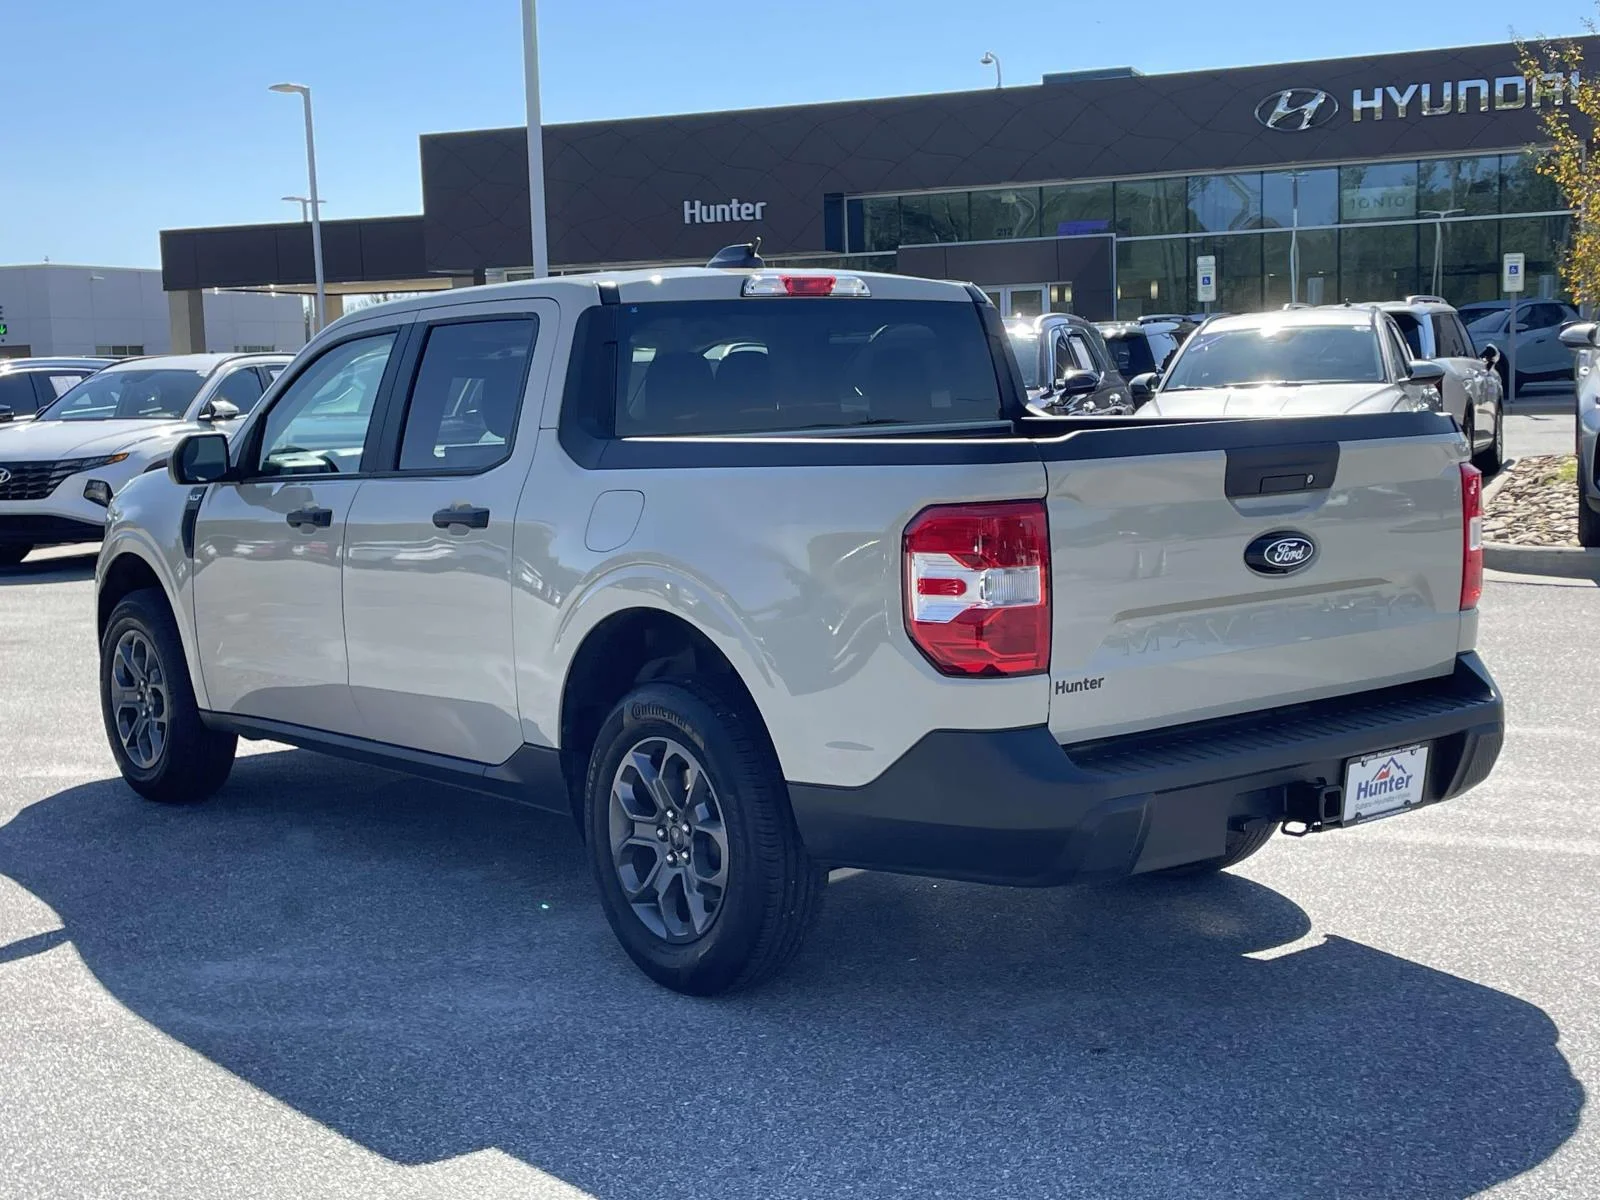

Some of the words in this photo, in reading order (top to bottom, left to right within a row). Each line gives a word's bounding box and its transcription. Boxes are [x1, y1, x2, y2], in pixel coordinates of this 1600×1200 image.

[1352, 72, 1580, 122] HYUNDAI
[683, 199, 767, 224] Hunter
[1274, 542, 1305, 562] Ford
[1055, 677, 1105, 695] Hunter
[1356, 775, 1413, 800] Hunter
